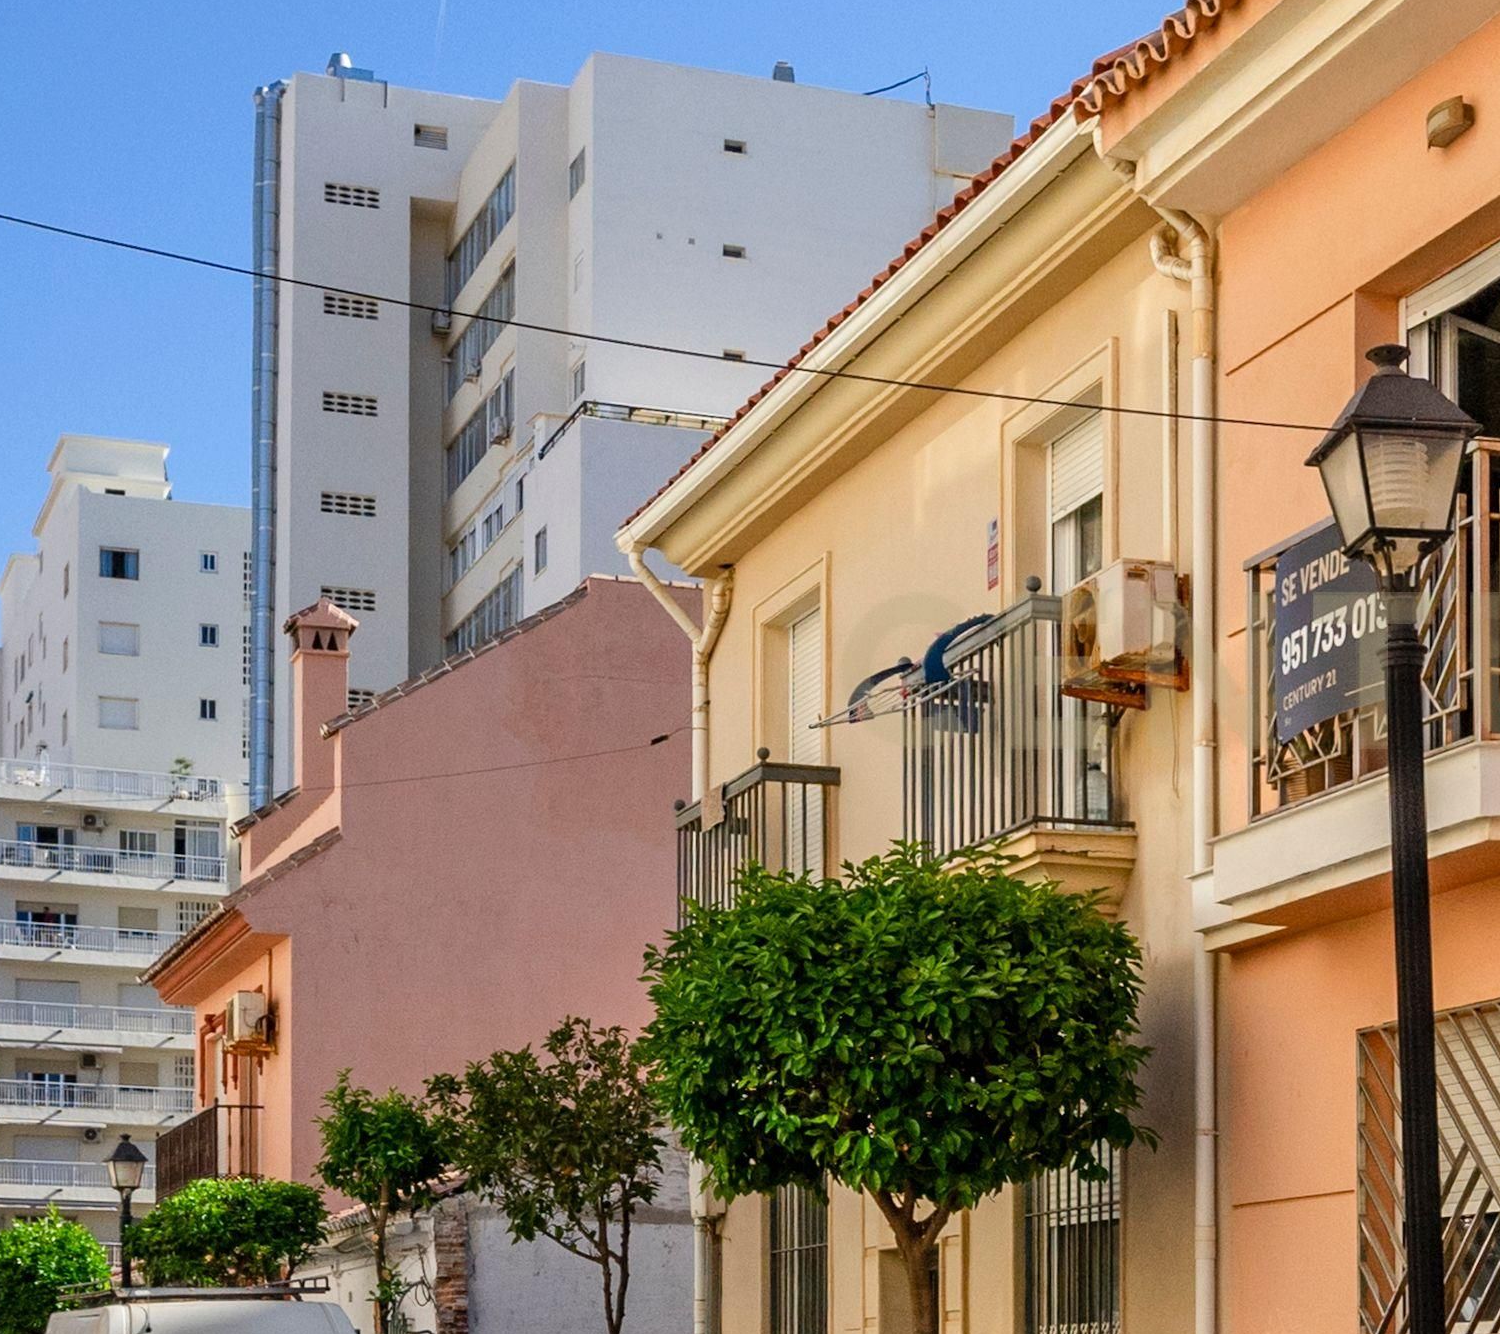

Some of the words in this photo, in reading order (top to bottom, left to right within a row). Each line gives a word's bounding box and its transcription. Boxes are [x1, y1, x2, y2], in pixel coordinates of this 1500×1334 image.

[1281, 571, 1298, 607] SE
[1300, 545, 1350, 595] VENDE
[1281, 626, 1308, 675] 951
[1311, 604, 1347, 659] 733
[1283, 674, 1325, 711] CENTURY
[1325, 668, 1337, 688] 21
